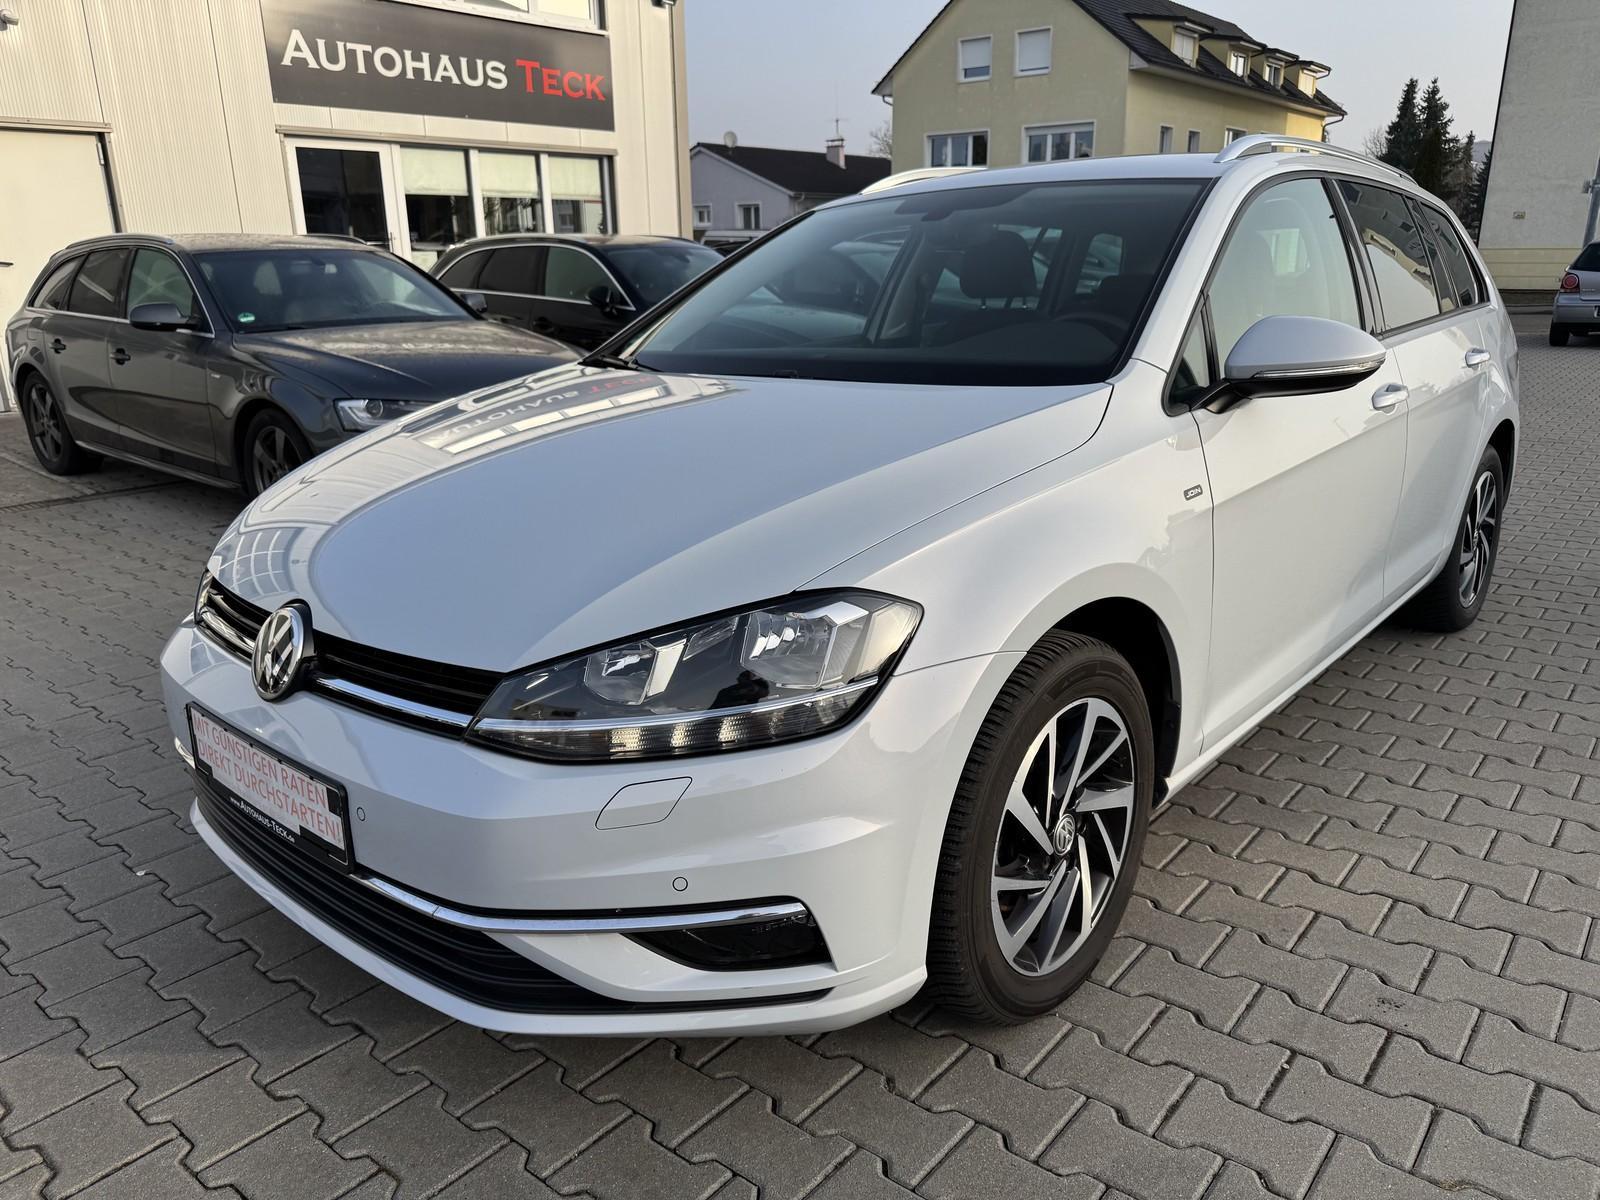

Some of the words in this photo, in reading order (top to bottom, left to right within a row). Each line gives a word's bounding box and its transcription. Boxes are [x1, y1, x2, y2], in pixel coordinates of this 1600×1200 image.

[280, 28, 509, 91] AUTOHAUS
[515, 58, 606, 101] TECK
[193, 712, 210, 738] MIT
[281, 767, 326, 809] RATEN
[198, 738, 231, 775] DIREKT
[234, 762, 343, 844] DURCHSTARTEN!
